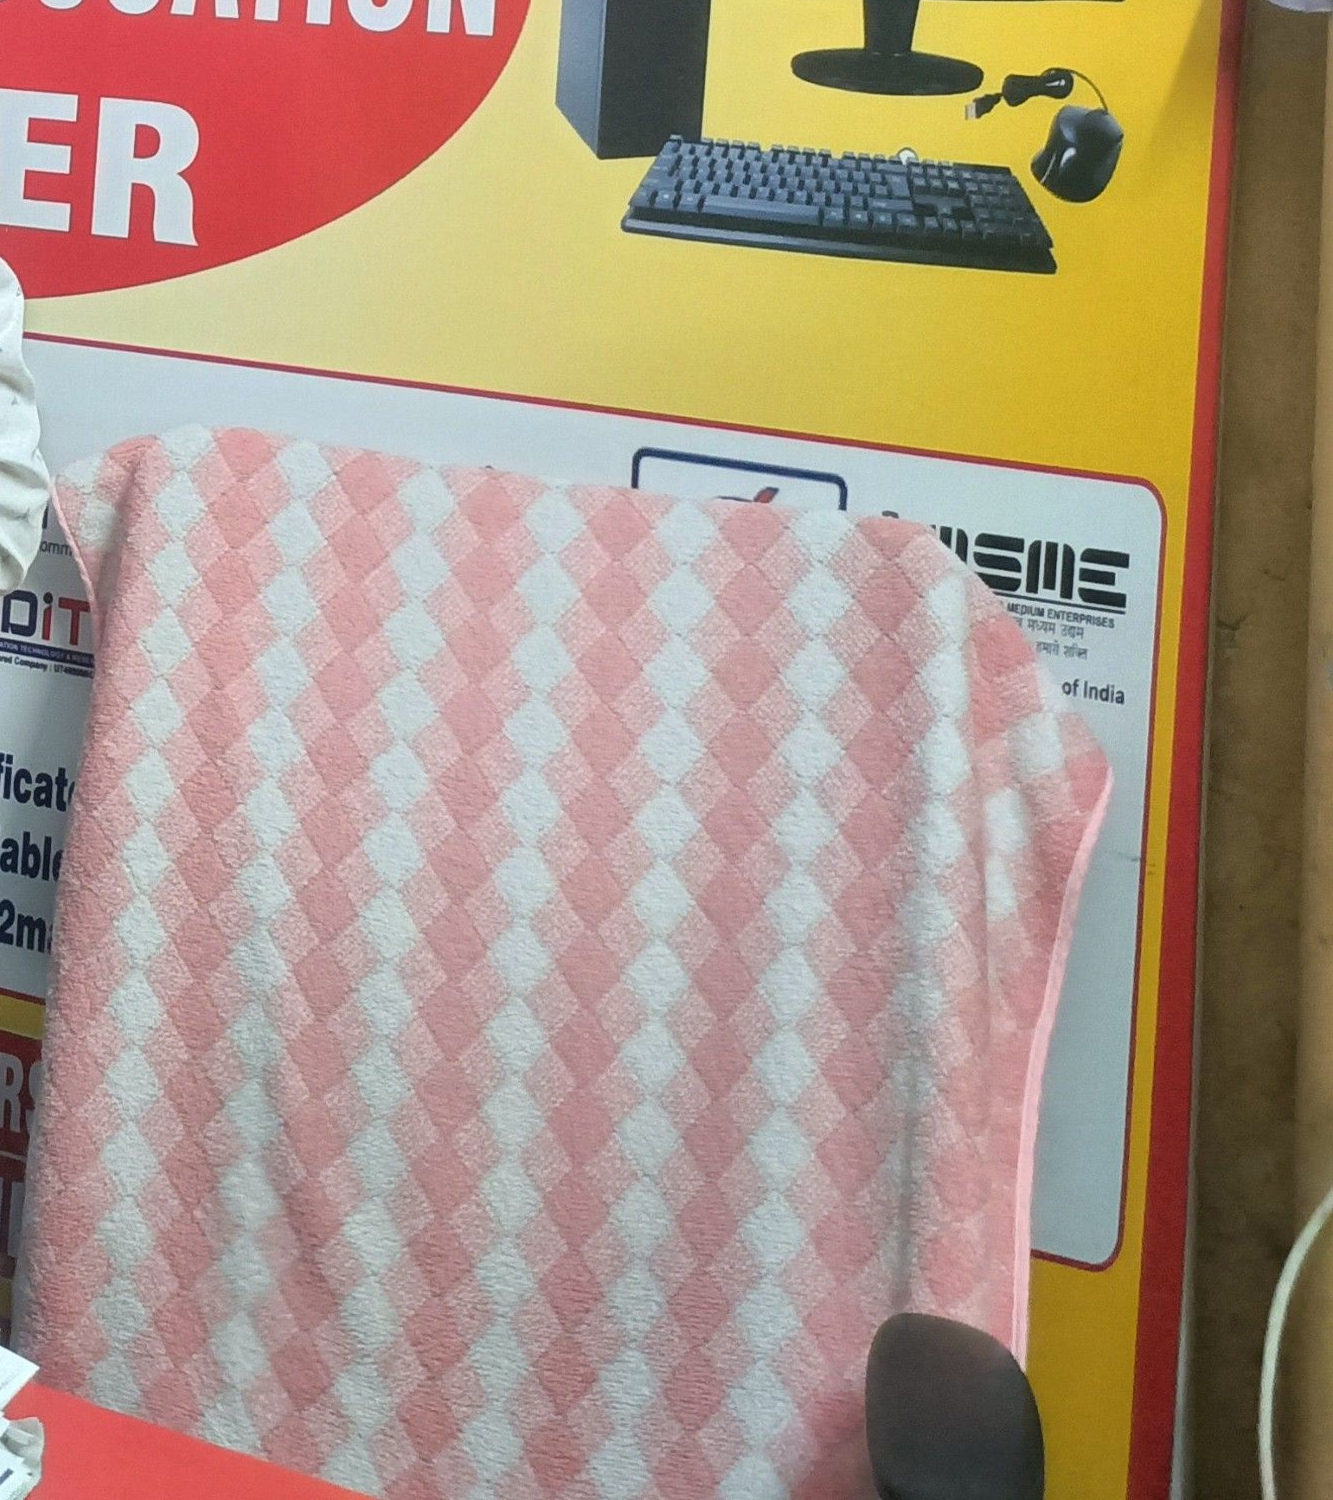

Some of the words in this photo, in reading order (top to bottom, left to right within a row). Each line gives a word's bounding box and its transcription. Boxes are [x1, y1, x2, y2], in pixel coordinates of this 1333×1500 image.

[1, 590, 91, 646] DiT
[1007, 603, 1045, 617] MEDIUM
[1047, 609, 1115, 629] ENTERPRISES
[14, 656, 48, 672] Company
[1061, 679, 1080, 697] of
[1083, 680, 1126, 705] India
